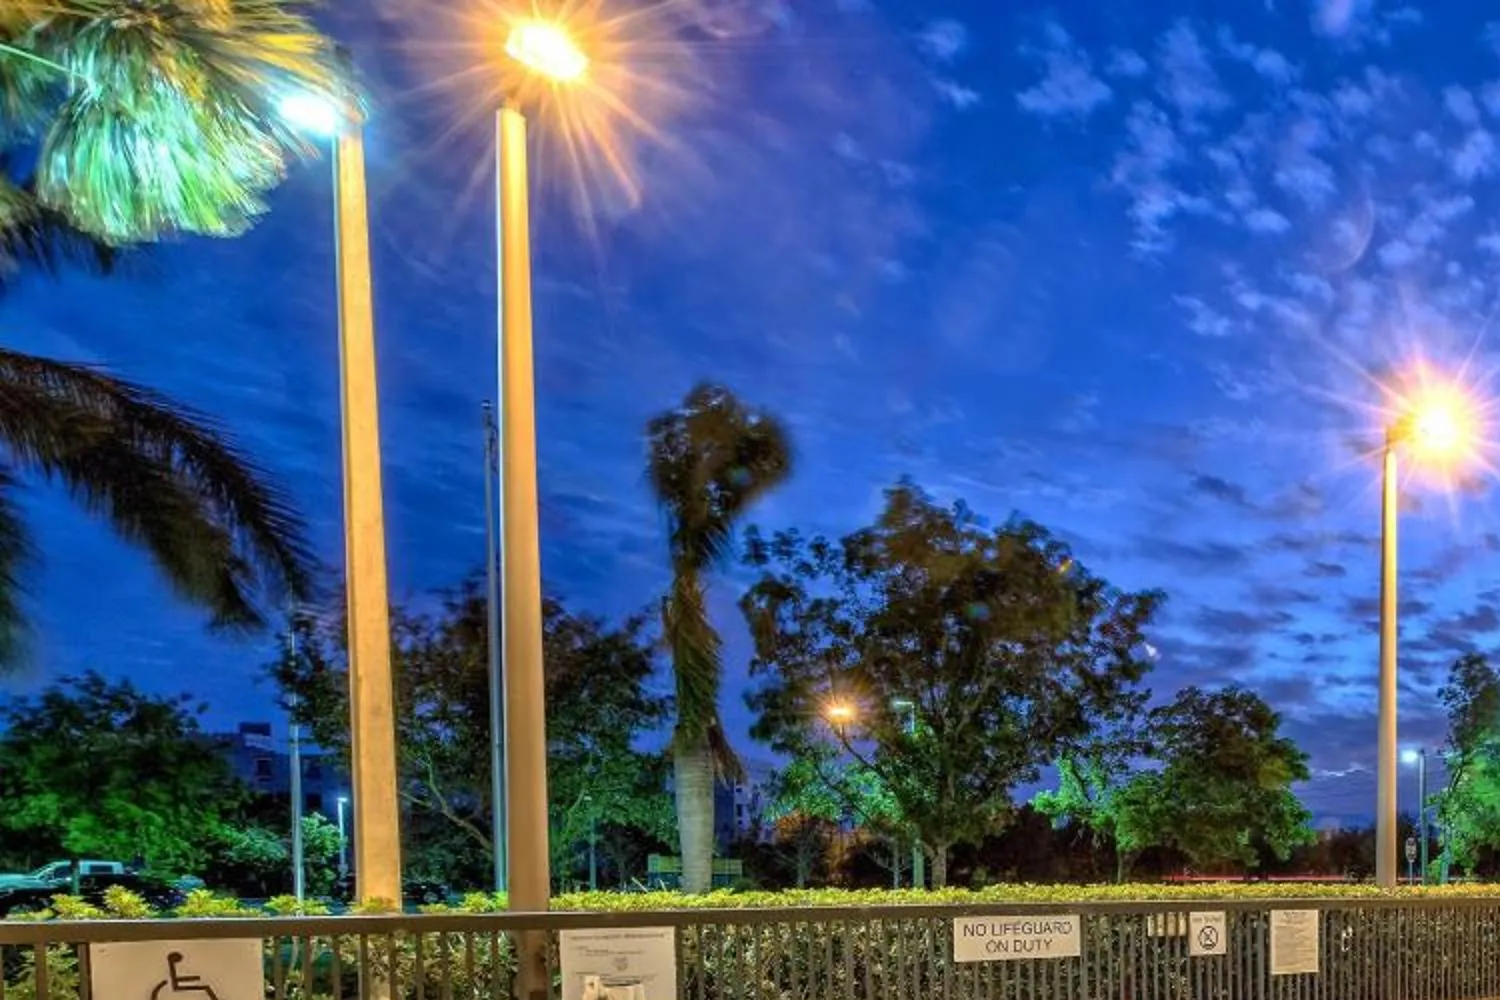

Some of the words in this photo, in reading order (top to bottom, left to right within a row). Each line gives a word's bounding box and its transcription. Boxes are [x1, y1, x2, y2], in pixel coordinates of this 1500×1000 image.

[963, 923, 987, 937] NO
[991, 921, 1073, 937] LIFEGUARD
[985, 940, 1009, 953] ON
[1013, 939, 1053, 952] DUTY
